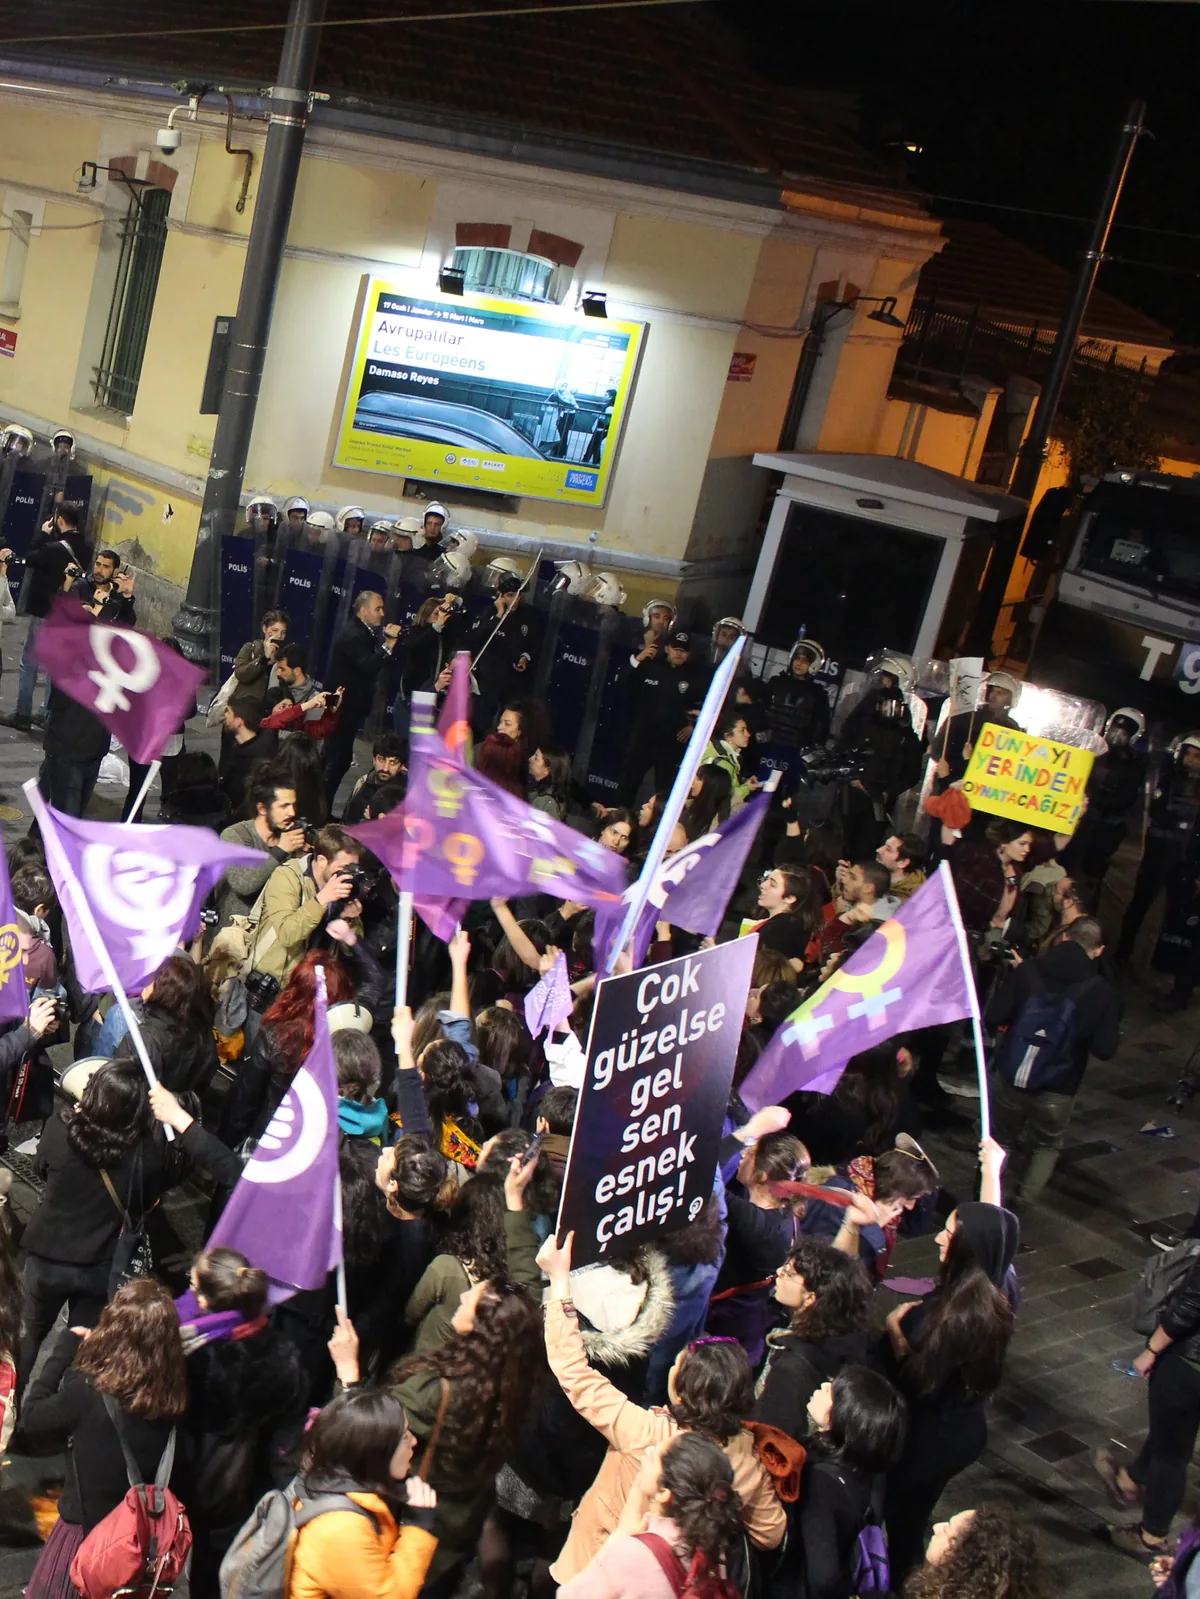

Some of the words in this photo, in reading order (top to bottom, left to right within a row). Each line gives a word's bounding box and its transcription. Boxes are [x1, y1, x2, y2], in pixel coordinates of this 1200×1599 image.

[378, 320, 465, 345] Avrupalılar
[468, 316, 484, 324] Mars
[368, 365, 408, 380] Damaso
[409, 371, 439, 385] Reyes
[373, 340, 400, 357] Les
[405, 346, 485, 371] Européens
[15, 496, 34, 505] POLİS
[228, 563, 248, 573] POLİS
[289, 576, 311, 588] POLİS
[563, 652, 587, 666] POLİS
[1139, 635, 1175, 682] T
[760, 757, 789, 771] POLİS
[981, 729, 1071, 769] DÜNYAYI
[976, 751, 1083, 794] YERİNDEN
[963, 781, 1080, 825] OYNATACAĞIZ!
[636, 958, 703, 1025] Çok
[592, 1002, 726, 1091] güzelse
[629, 1052, 683, 1118] gel
[620, 1103, 682, 1154] sen
[595, 1133, 698, 1204] esnek
[596, 1170, 688, 1254] çalış!
